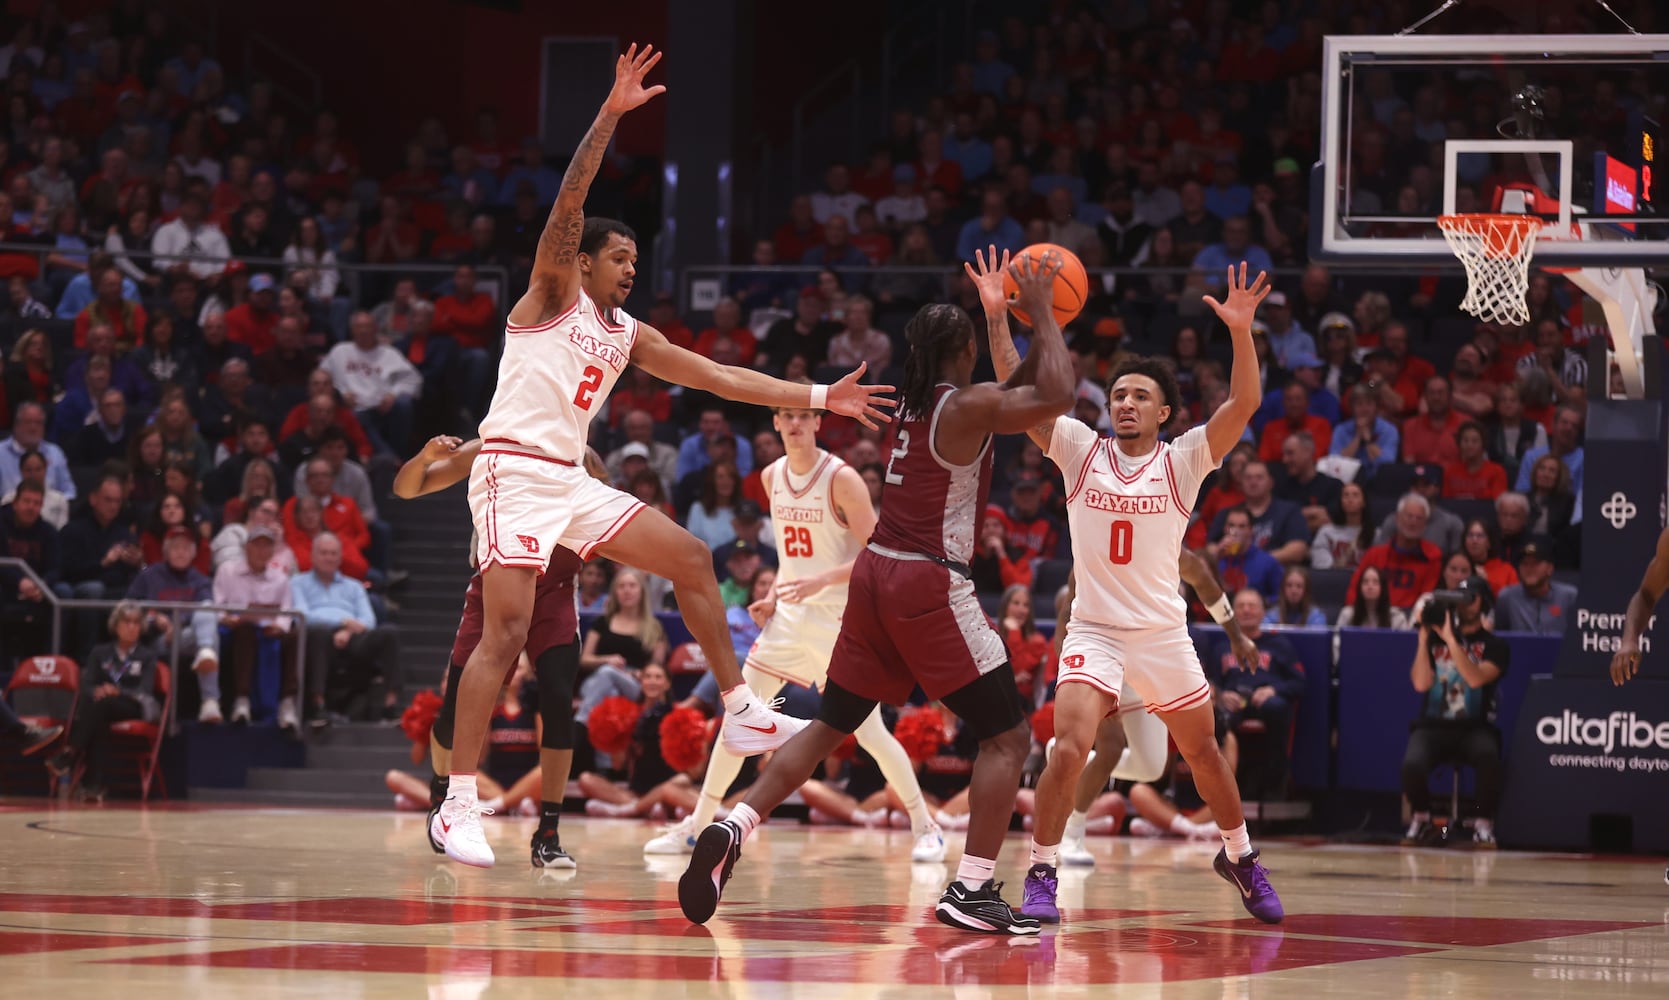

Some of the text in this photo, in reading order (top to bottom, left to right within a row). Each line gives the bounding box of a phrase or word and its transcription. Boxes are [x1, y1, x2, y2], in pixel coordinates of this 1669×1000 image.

[573, 365, 604, 411] 2
[885, 429, 910, 486] 2
[775, 505, 823, 523] DAYTON
[1085, 488, 1168, 514] DAYTON
[784, 526, 813, 558] 29
[1109, 520, 1133, 565] 0
[1577, 608, 1656, 631] Premr
[1582, 632, 1650, 653] Heah
[1550, 754, 1626, 772] connecting
